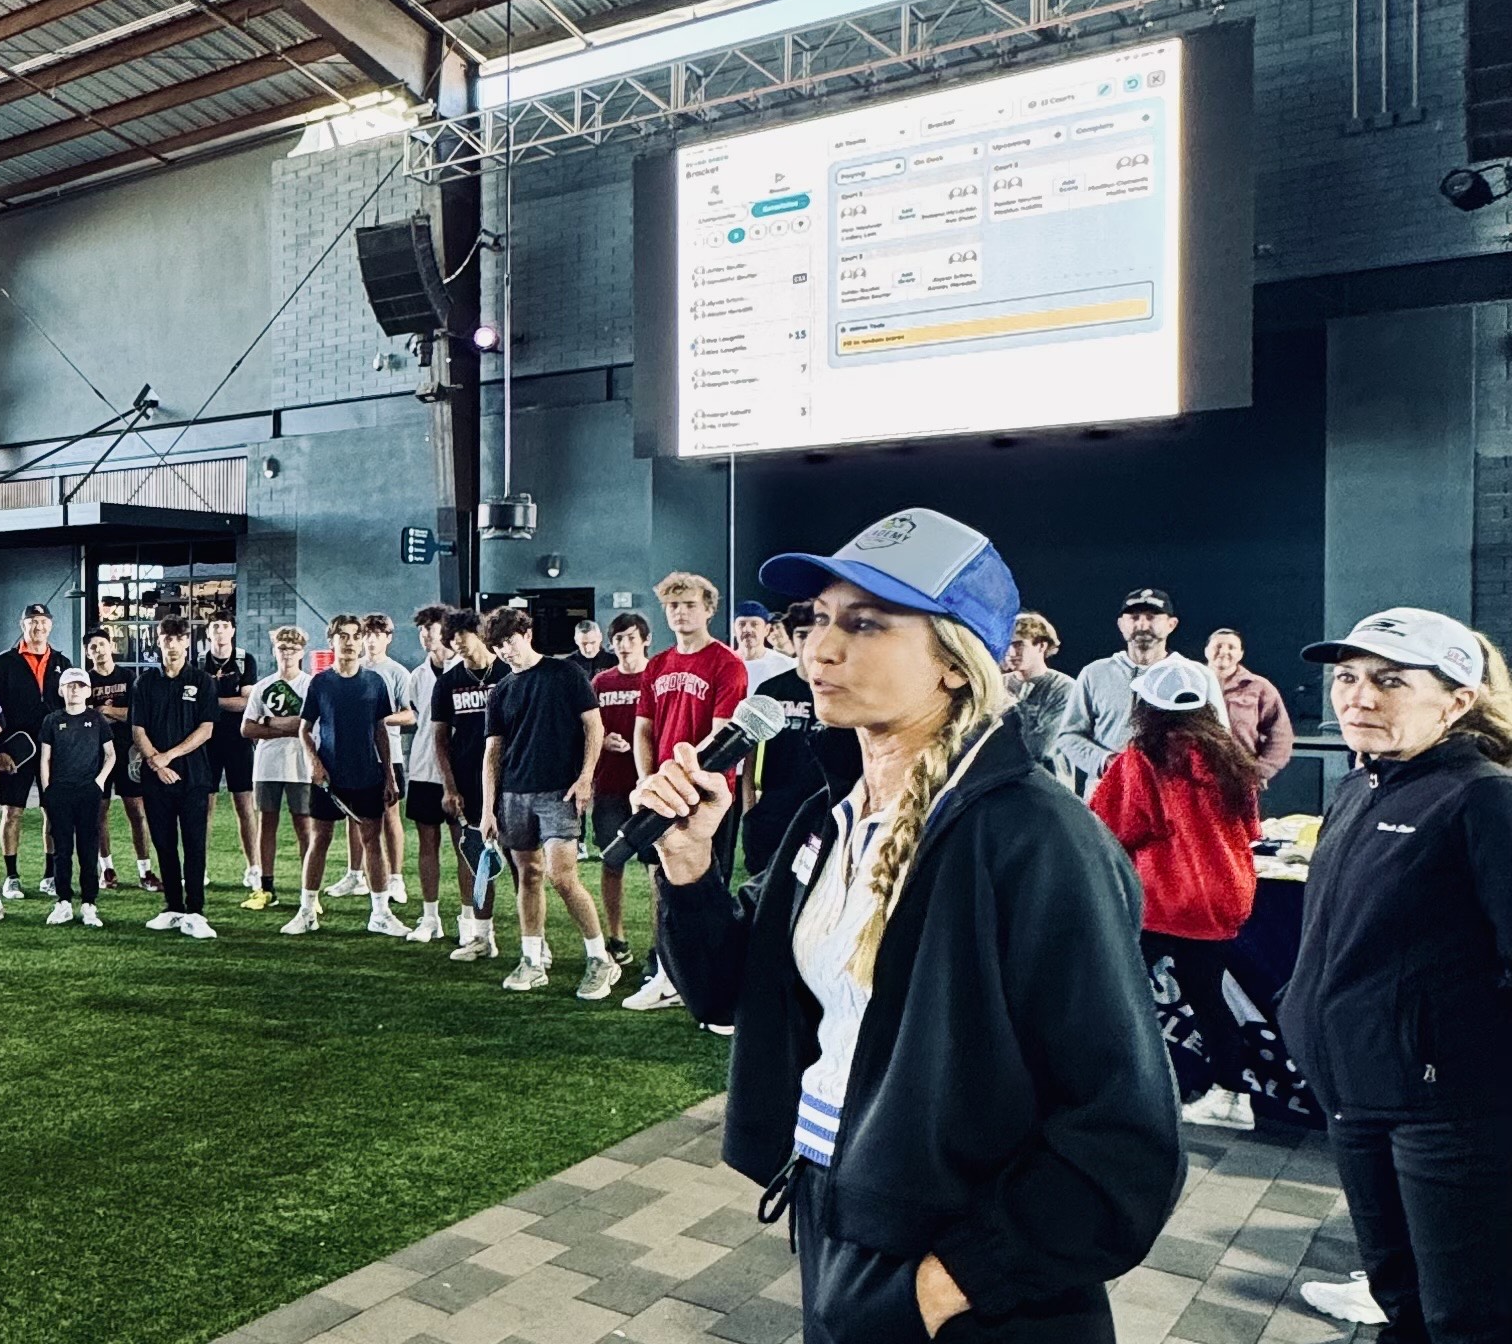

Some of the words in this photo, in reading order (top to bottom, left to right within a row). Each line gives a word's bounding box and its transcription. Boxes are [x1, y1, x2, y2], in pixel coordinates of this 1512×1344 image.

[1050, 94, 1075, 105] Courts
[992, 139, 1031, 151] Upcoming
[685, 165, 720, 180] Bracket
[794, 329, 807, 340] 15
[452, 688, 492, 710] BRON
